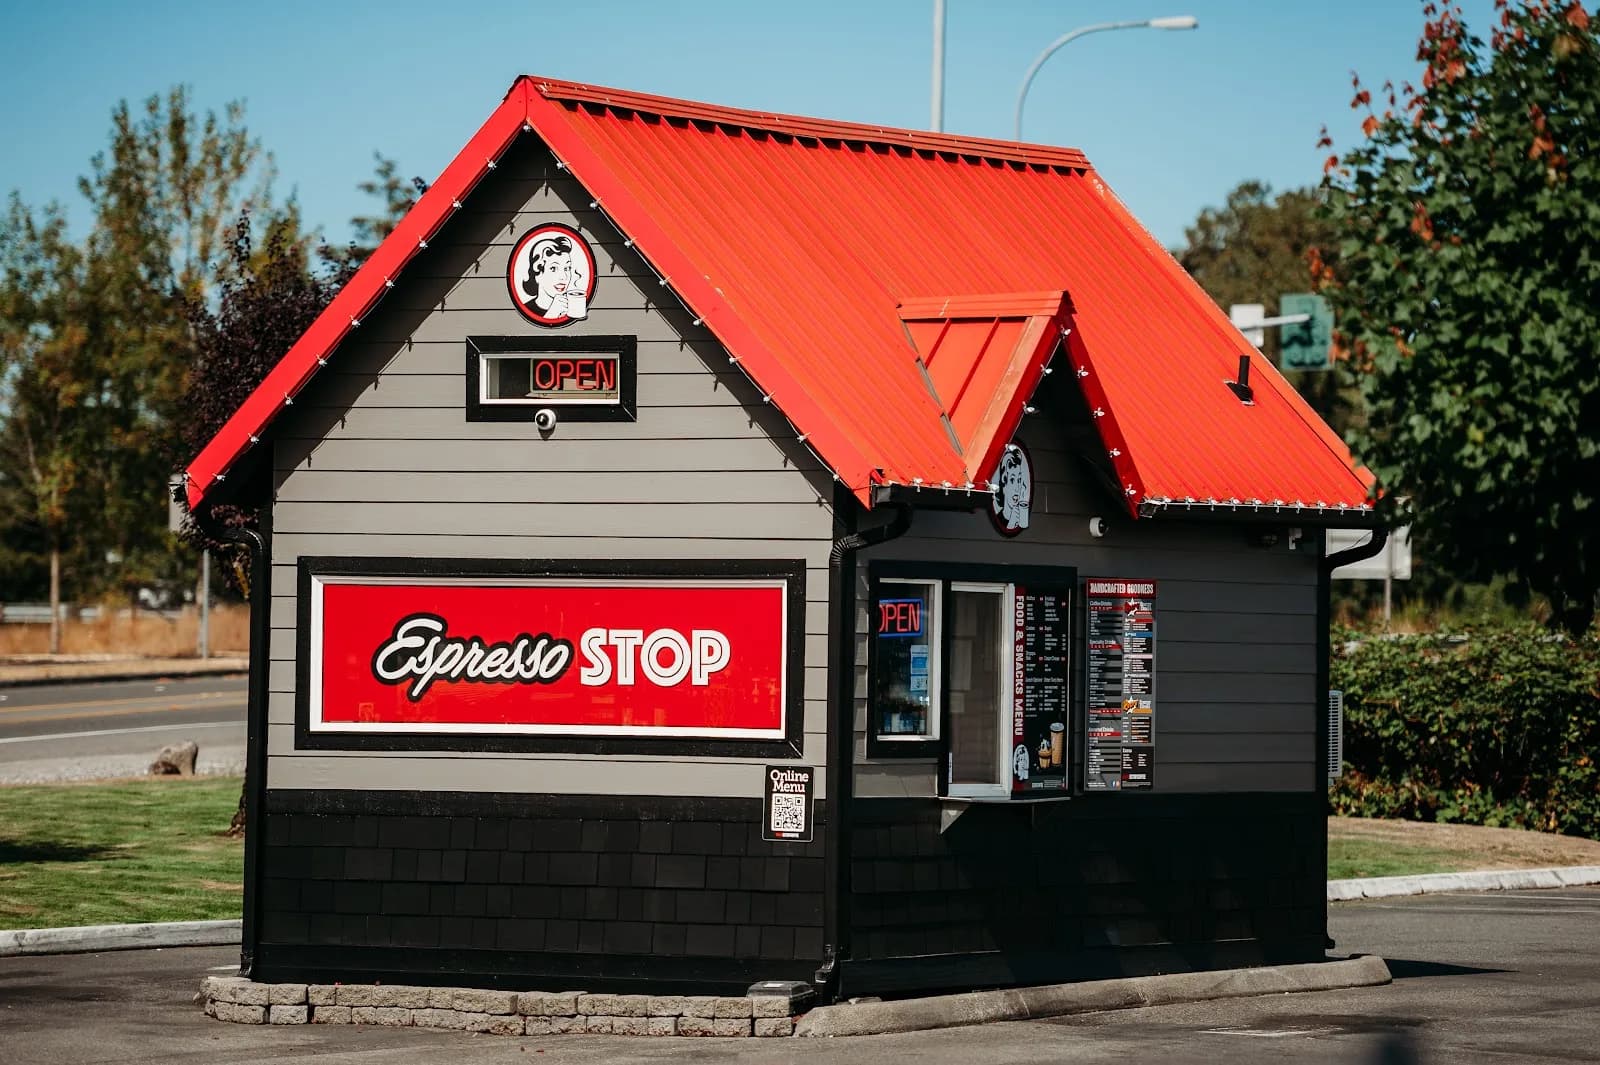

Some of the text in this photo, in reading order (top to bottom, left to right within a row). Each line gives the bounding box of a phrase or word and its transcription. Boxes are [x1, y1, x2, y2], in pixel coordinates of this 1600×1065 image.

[535, 360, 615, 390] OPEN
[1090, 583, 1154, 594] HANDCRAFTED GOODNESS
[374, 615, 731, 699] Espresso STOP
[1014, 596, 1024, 735] FOOD & SNACKS MENU
[770, 769, 809, 783] Online
[772, 780, 806, 793] Menu
